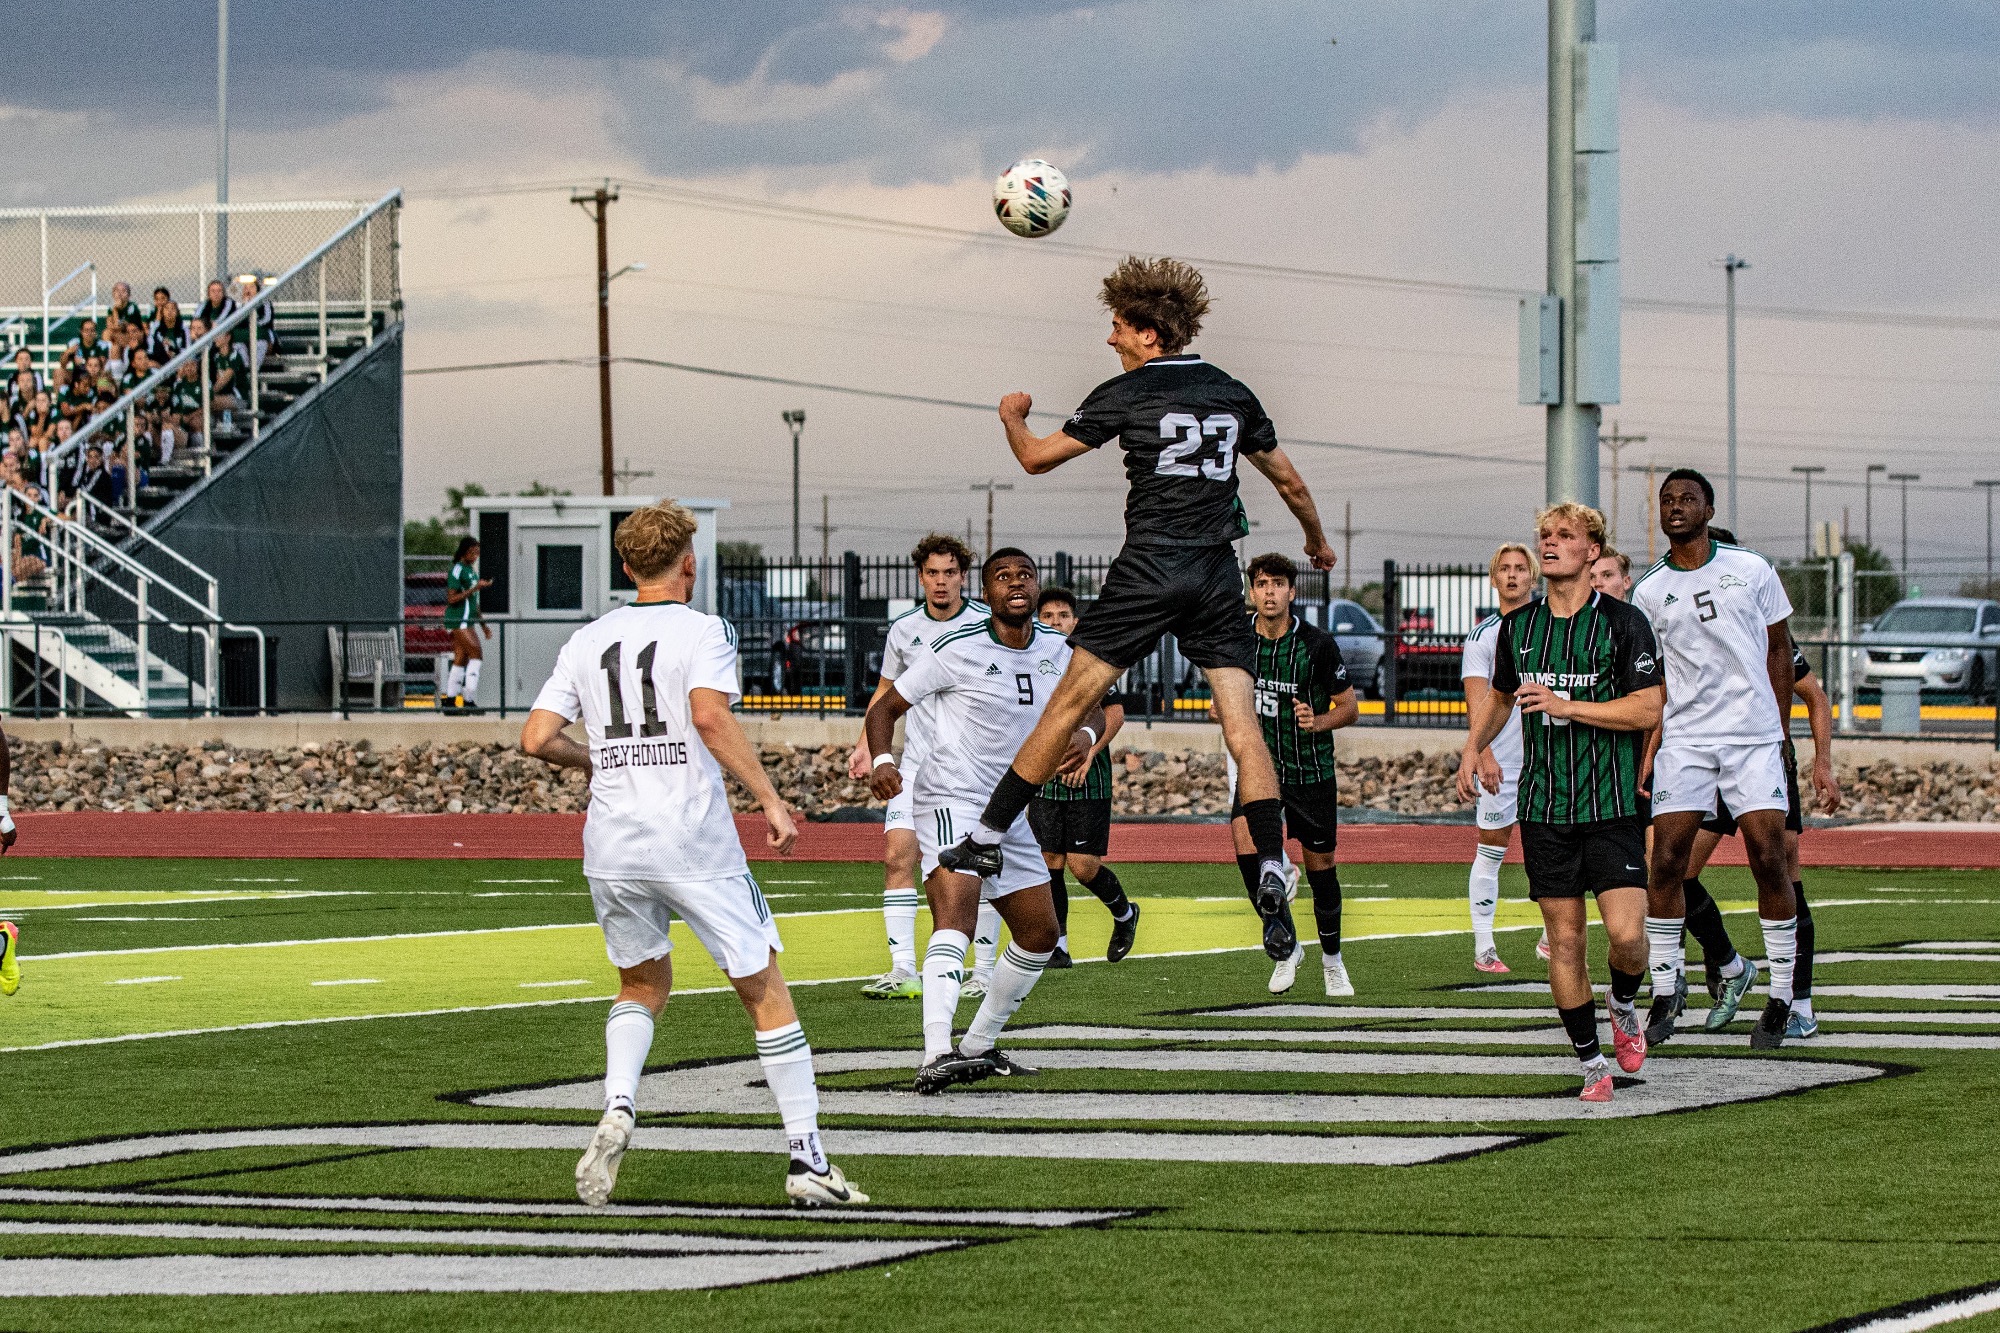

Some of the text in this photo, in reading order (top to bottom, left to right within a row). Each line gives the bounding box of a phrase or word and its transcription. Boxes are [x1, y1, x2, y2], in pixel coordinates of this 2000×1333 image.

[1154, 412, 1239, 482] 23
[1693, 590, 1717, 622] 5
[600, 641, 668, 739] 11
[1015, 674, 1033, 705] 9
[1268, 680, 1298, 693] STATE
[1559, 674, 1599, 687] STATE
[1254, 689, 1278, 717] 15
